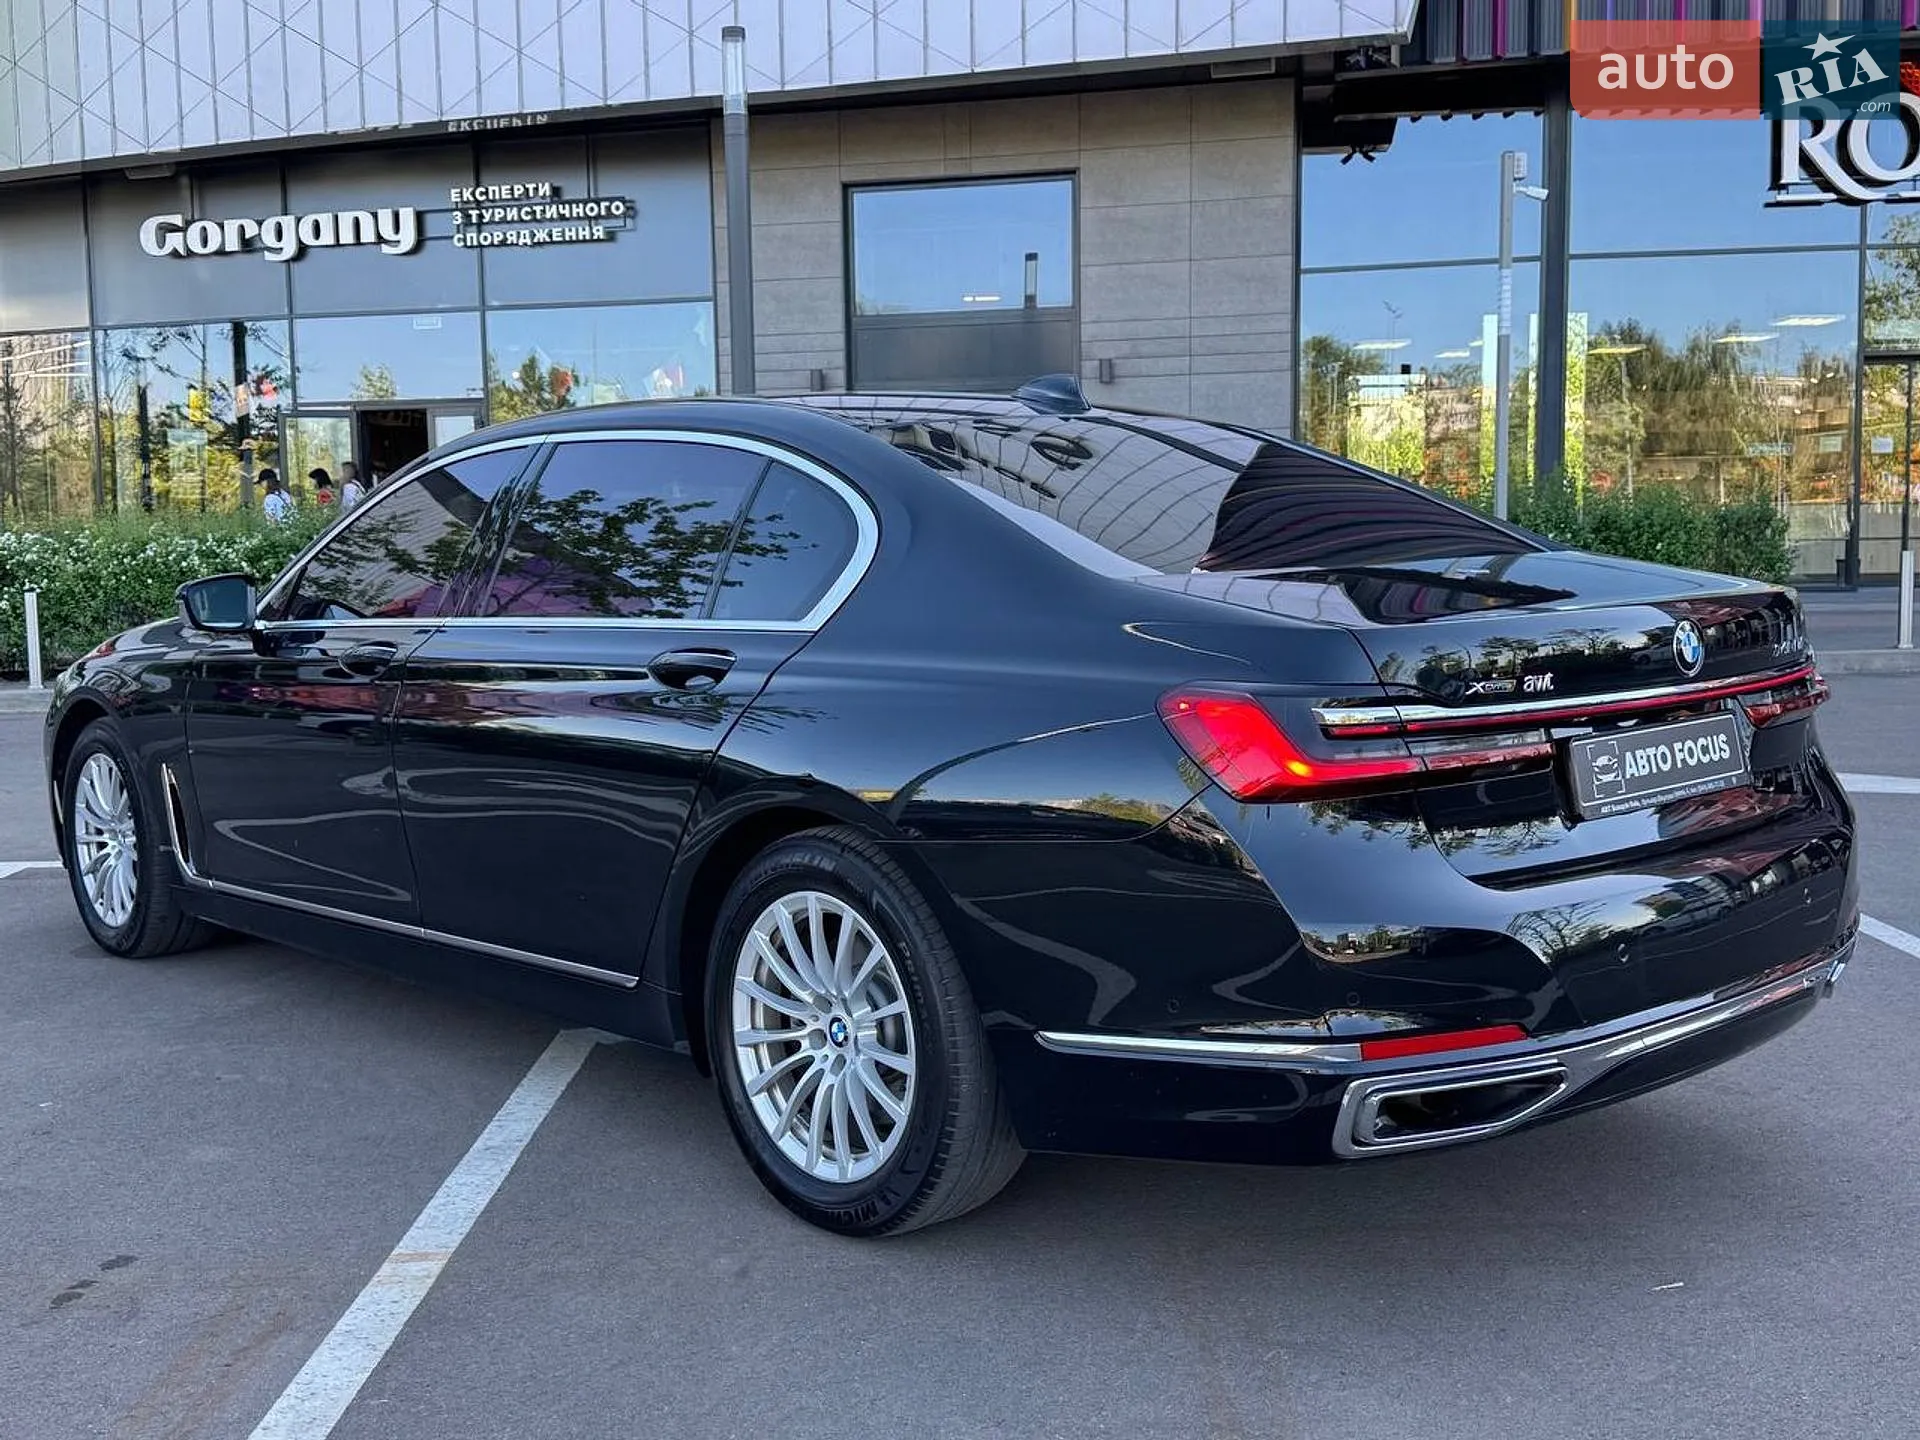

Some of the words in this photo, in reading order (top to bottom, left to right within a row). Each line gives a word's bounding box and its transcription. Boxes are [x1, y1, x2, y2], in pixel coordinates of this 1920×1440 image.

[450, 182, 551, 202] ЕКСПЕРТИ
[469, 201, 625, 225] ТУРИСТИЧНОГО
[139, 206, 416, 261] Gorgany
[453, 226, 605, 248] СПОРЯДЖЕННЯ
[1673, 733, 1731, 769] FOCUS
